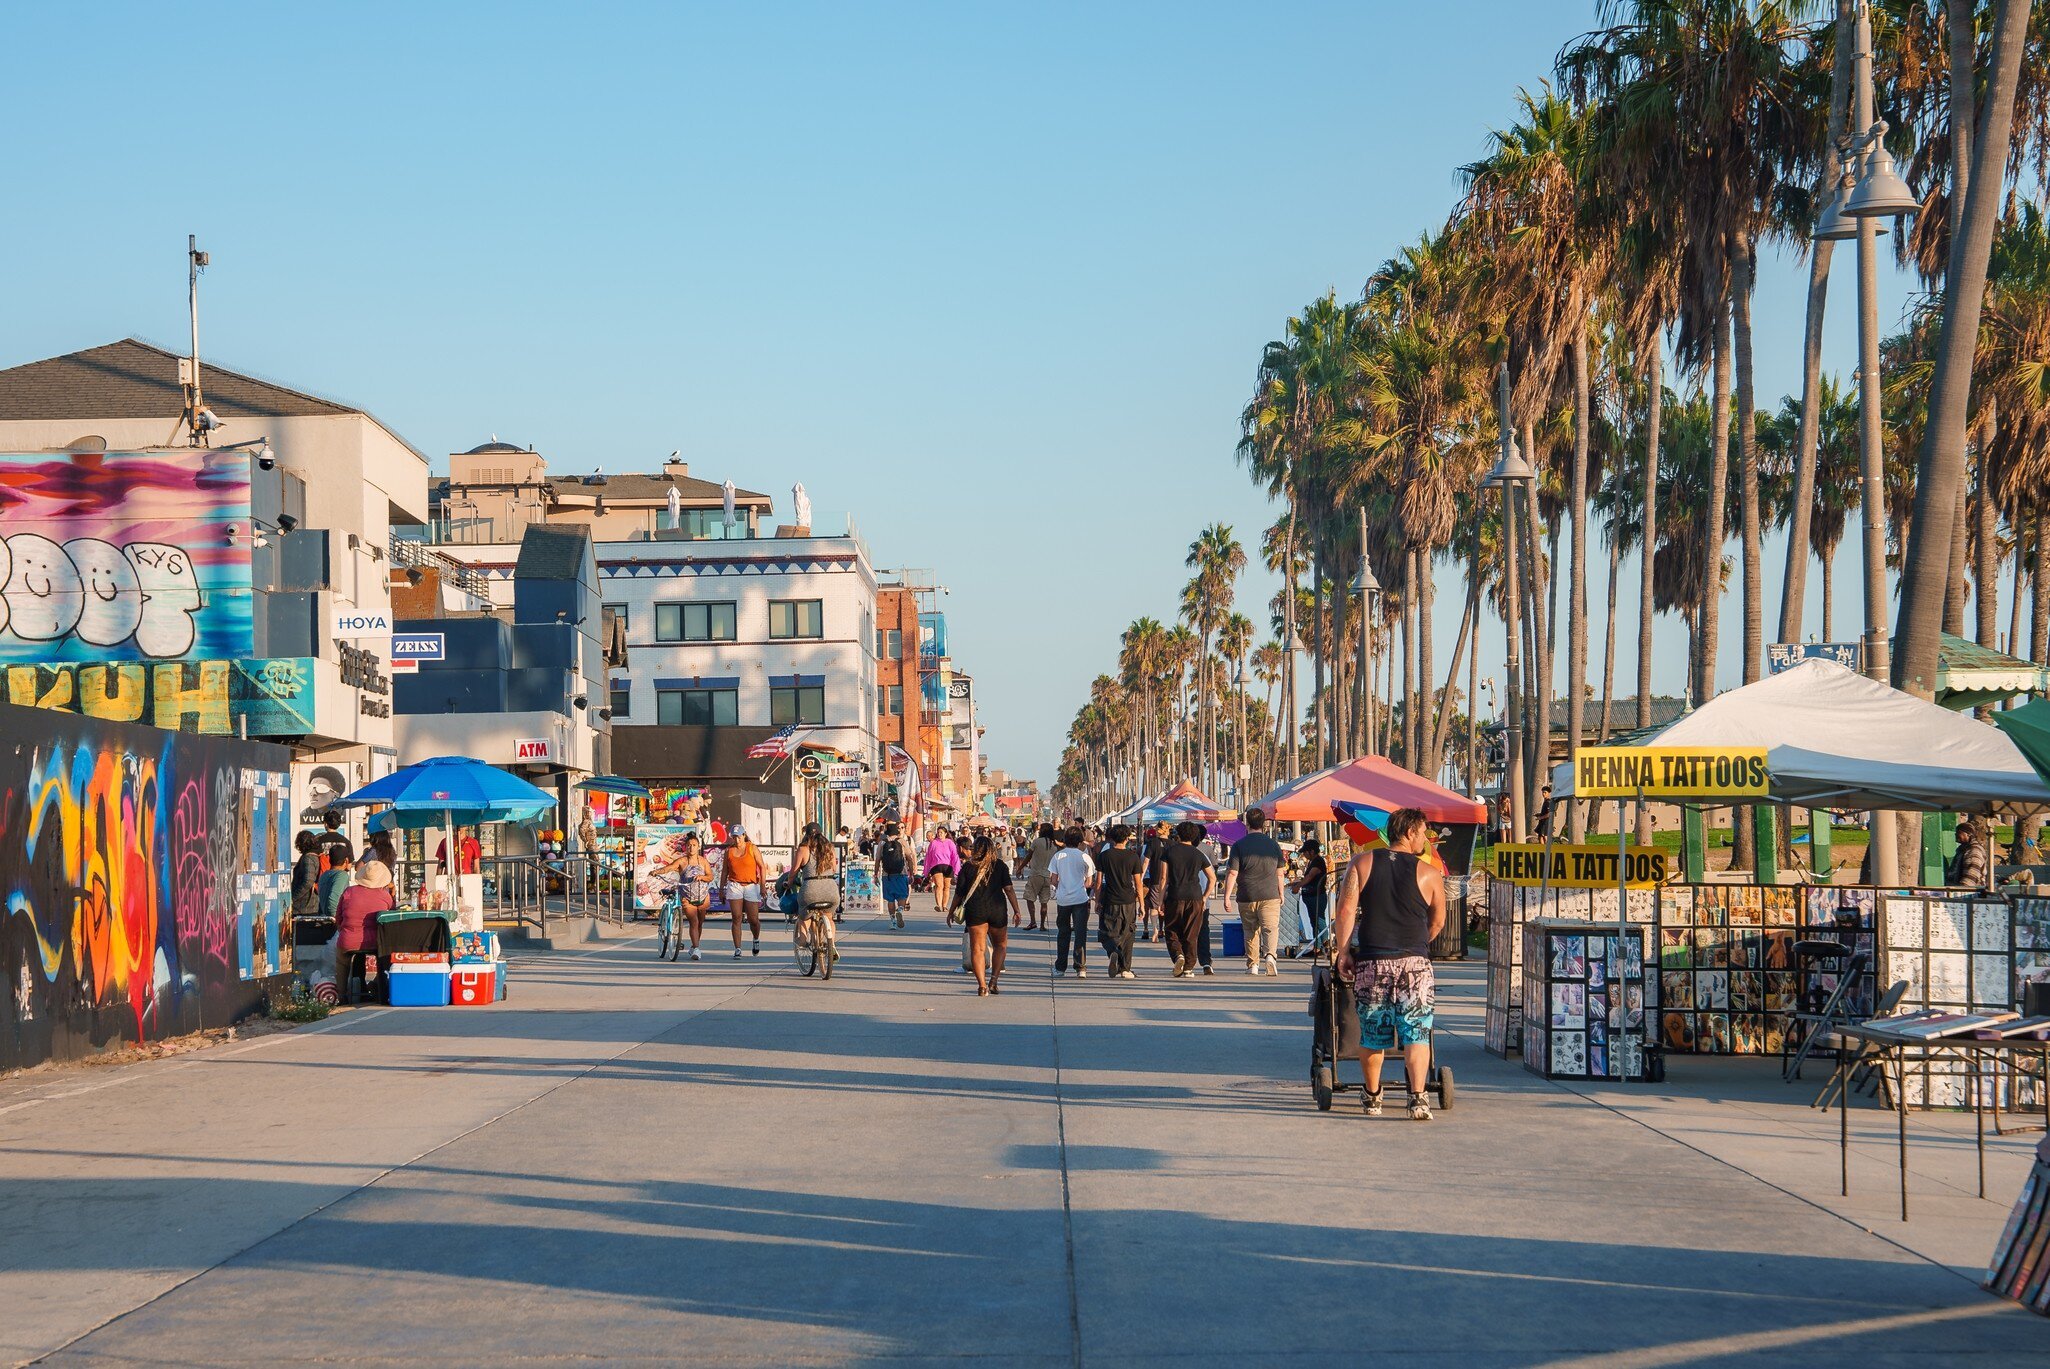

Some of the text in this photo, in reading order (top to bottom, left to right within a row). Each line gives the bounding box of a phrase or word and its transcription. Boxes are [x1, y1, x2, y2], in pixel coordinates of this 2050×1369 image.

[131, 545, 183, 575] KYS
[338, 617, 387, 629] HOYA
[395, 641, 438, 653] ZEISS
[519, 742, 547, 757] ATM
[830, 767, 859, 777] MARKET
[1580, 755, 1764, 788] HENNA TATTOOS
[844, 795, 859, 803] ATM
[1498, 851, 1664, 882] HENNA TATTOOS
